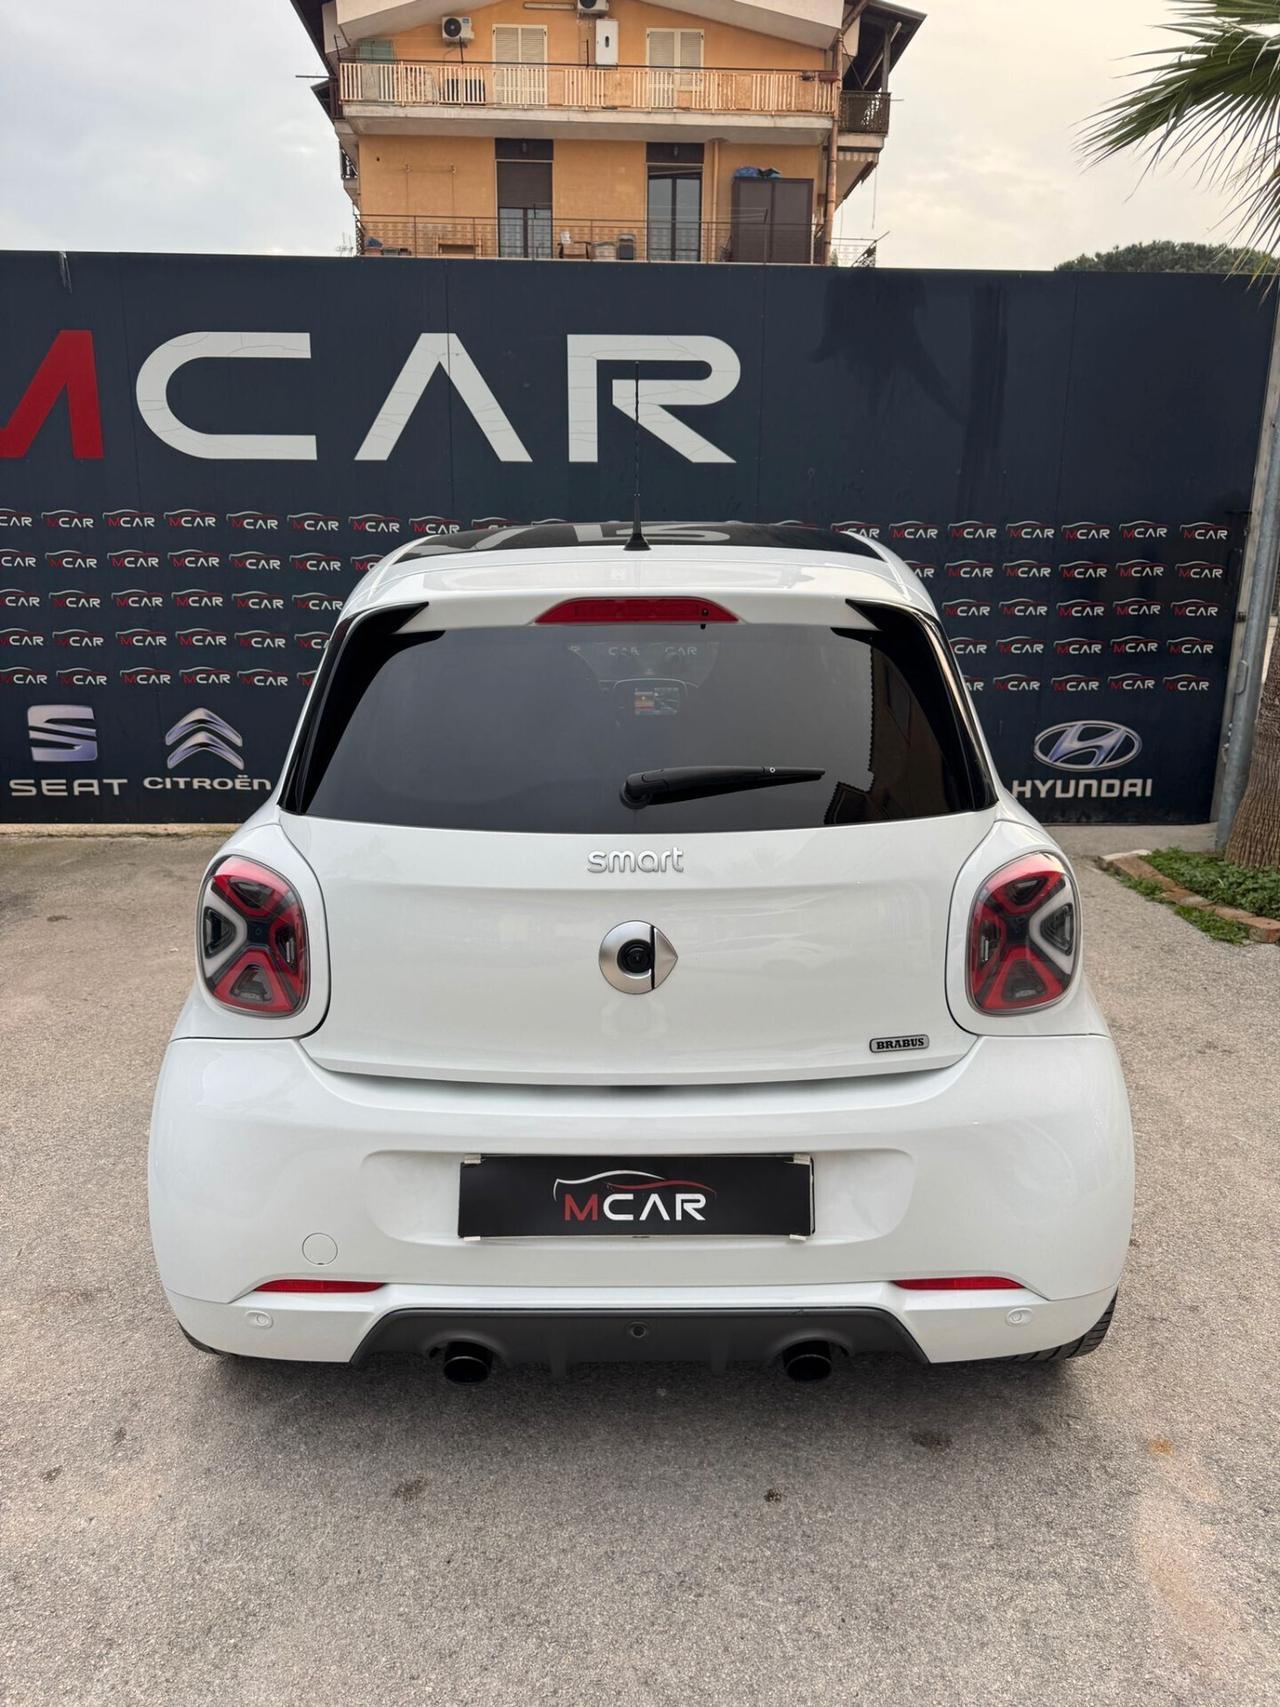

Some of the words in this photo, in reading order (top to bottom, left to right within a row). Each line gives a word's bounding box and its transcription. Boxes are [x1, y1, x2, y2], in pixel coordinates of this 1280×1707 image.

[0, 516, 33, 527] CAR
[48, 517, 94, 528] MCAR
[107, 516, 155, 528] MCAR
[168, 516, 217, 527] MCAR
[232, 519, 279, 530] MCAR
[293, 520, 340, 531] MCAR
[353, 520, 400, 533] MCAR
[413, 523, 460, 534] MCAR
[891, 528, 939, 539] MCAR
[951, 528, 997, 539] MCAR
[1009, 528, 1055, 539] MCAR
[1065, 528, 1111, 540] MCAR
[1121, 527, 1168, 539] MCAR
[1183, 529, 1229, 540] MCAR
[0, 556, 37, 568] CAR
[50, 557, 98, 569] MCAR
[111, 556, 160, 568] MCAR
[172, 556, 220, 568] MCAR
[234, 558, 281, 570] MCAR
[294, 560, 342, 571] MCAR
[914, 567, 935, 578] AR
[946, 567, 994, 578] MCAR
[1006, 567, 1052, 578] MCAR
[1062, 567, 1108, 579] MCAR
[1119, 566, 1164, 577] MCAR
[1177, 568, 1223, 579] MCAR
[53, 597, 101, 609] MCAR
[116, 596, 164, 608] MCAR
[175, 596, 224, 608] MCAR
[236, 598, 284, 610] MCAR
[296, 599, 343, 611] MCAR
[944, 606, 991, 617] MCAR
[1002, 605, 1048, 616] MCAR
[1058, 606, 1105, 617] MCAR
[1115, 604, 1161, 616] MCAR
[1173, 606, 1219, 617] MCAR
[57, 636, 105, 648] MCAR
[119, 635, 168, 647] MCAR
[178, 635, 228, 647] MCAR
[239, 637, 286, 649] MCAR
[949, 644, 988, 654] CAR
[999, 643, 1045, 654] MCAR
[1055, 644, 1102, 655] MCAR
[1112, 642, 1159, 654] MCAR
[1167, 644, 1214, 655] MCAR
[60, 674, 108, 686] MCAR
[123, 673, 172, 685] MCAR
[182, 673, 231, 685] MCAR
[241, 675, 289, 687] MCAR
[995, 681, 1041, 691] MCAR
[1054, 681, 1100, 692] MCAR
[1109, 680, 1156, 690] MCAR
[1166, 681, 1210, 692] MCAR
[9, 778, 128, 797] SEAT
[1012, 778, 1153, 799] HYUNDAI
[587, 847, 684, 873] smart
[876, 1037, 925, 1050] BRABUS
[564, 1193, 706, 1221] MCAR
